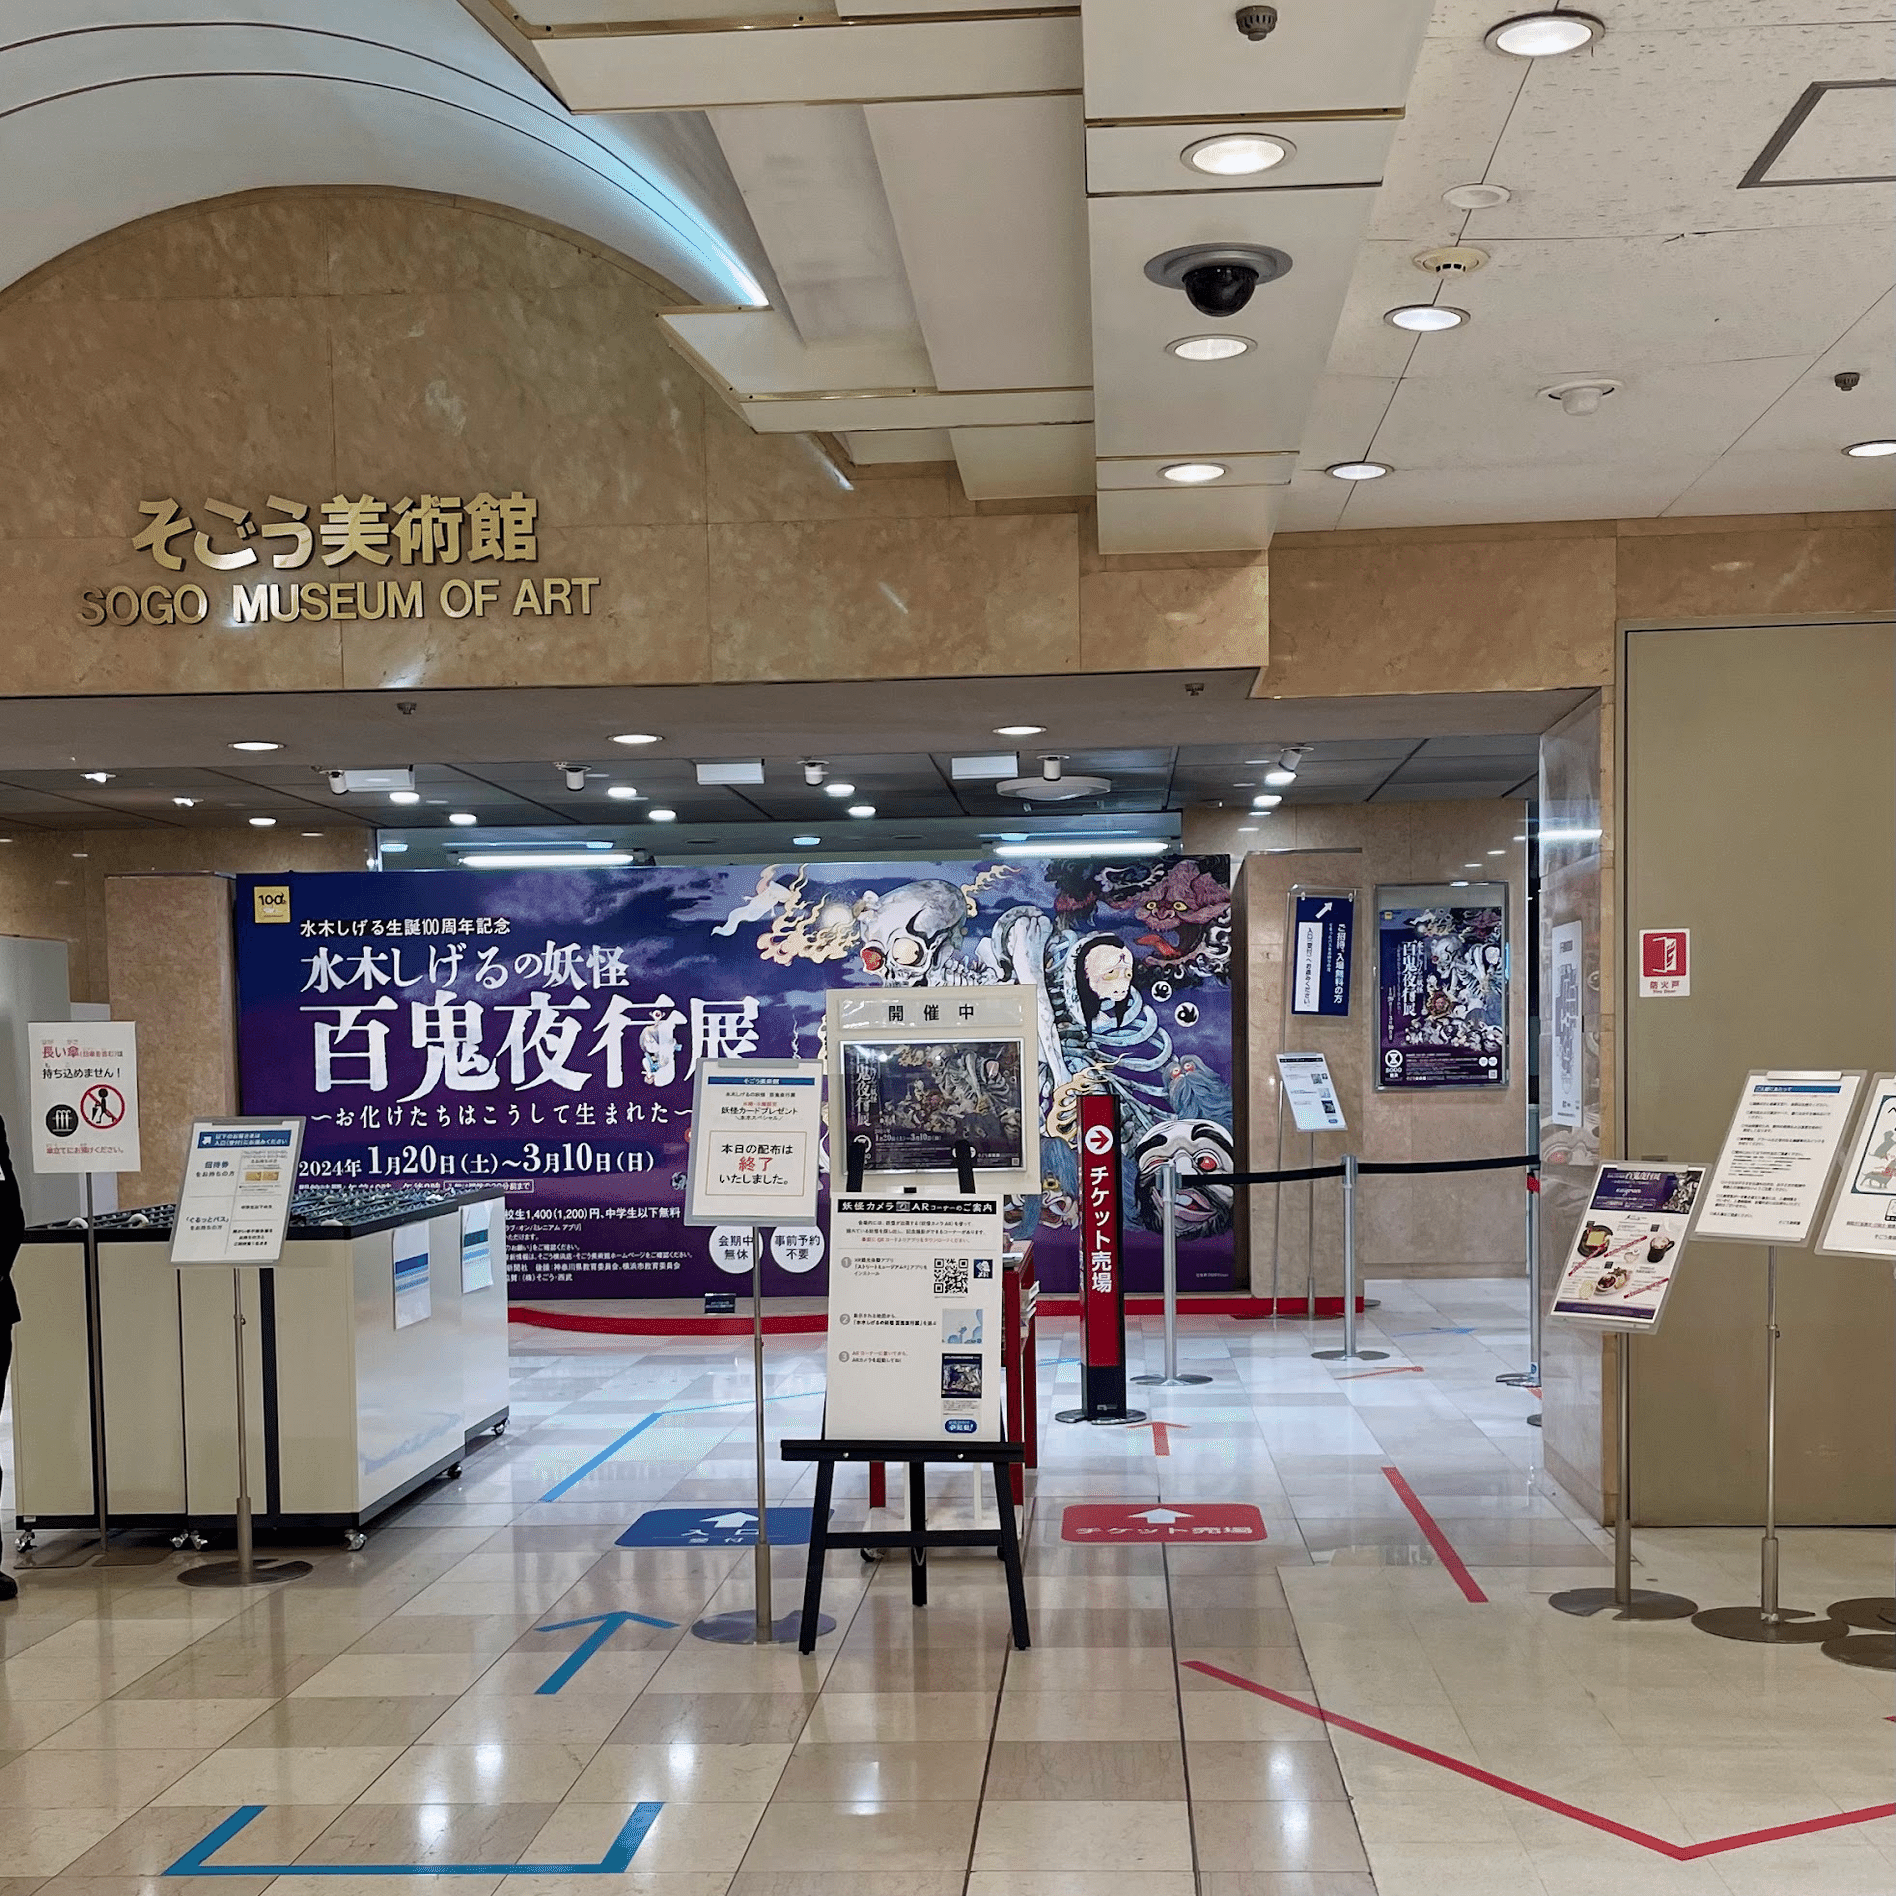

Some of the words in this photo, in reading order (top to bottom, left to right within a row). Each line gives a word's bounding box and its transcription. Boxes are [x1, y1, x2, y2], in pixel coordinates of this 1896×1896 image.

[132, 490, 538, 570] そごう美術館
[80, 583, 209, 626] SOGO
[232, 579, 425, 623] MUSEUM
[440, 578, 499, 618] OF
[513, 576, 601, 616] ART
[300, 918, 511, 938] 水木しげる生誕100周年記念
[300, 941, 630, 993] 水木しげるの妖怪
[1649, 980, 1680, 989] 防火戸
[888, 1003, 974, 1021] 開催中
[300, 989, 761, 1104] 百鬼夜行展
[721, 1106, 798, 1115] 妖怪カードプレゼント
[721, 1144, 793, 1155] 本日の配布は
[299, 1158, 362, 1178] 2024年
[738, 1156, 774, 1172] 終了
[719, 1174, 788, 1185] いたしました。
[841, 1201, 894, 1211] 妖怪カメラ
[911, 1202, 993, 1213] ARコーナーのご案内
[1090, 1166, 1112, 1293] チケット売場
[506, 1233, 539, 1241] ただけます。
[718, 1235, 753, 1248] 会期中
[774, 1235, 820, 1247] 事前予約
[724, 1249, 749, 1260] 無休
[786, 1249, 809, 1260] 不要
[1075, 1526, 1253, 1534] チケット売場
